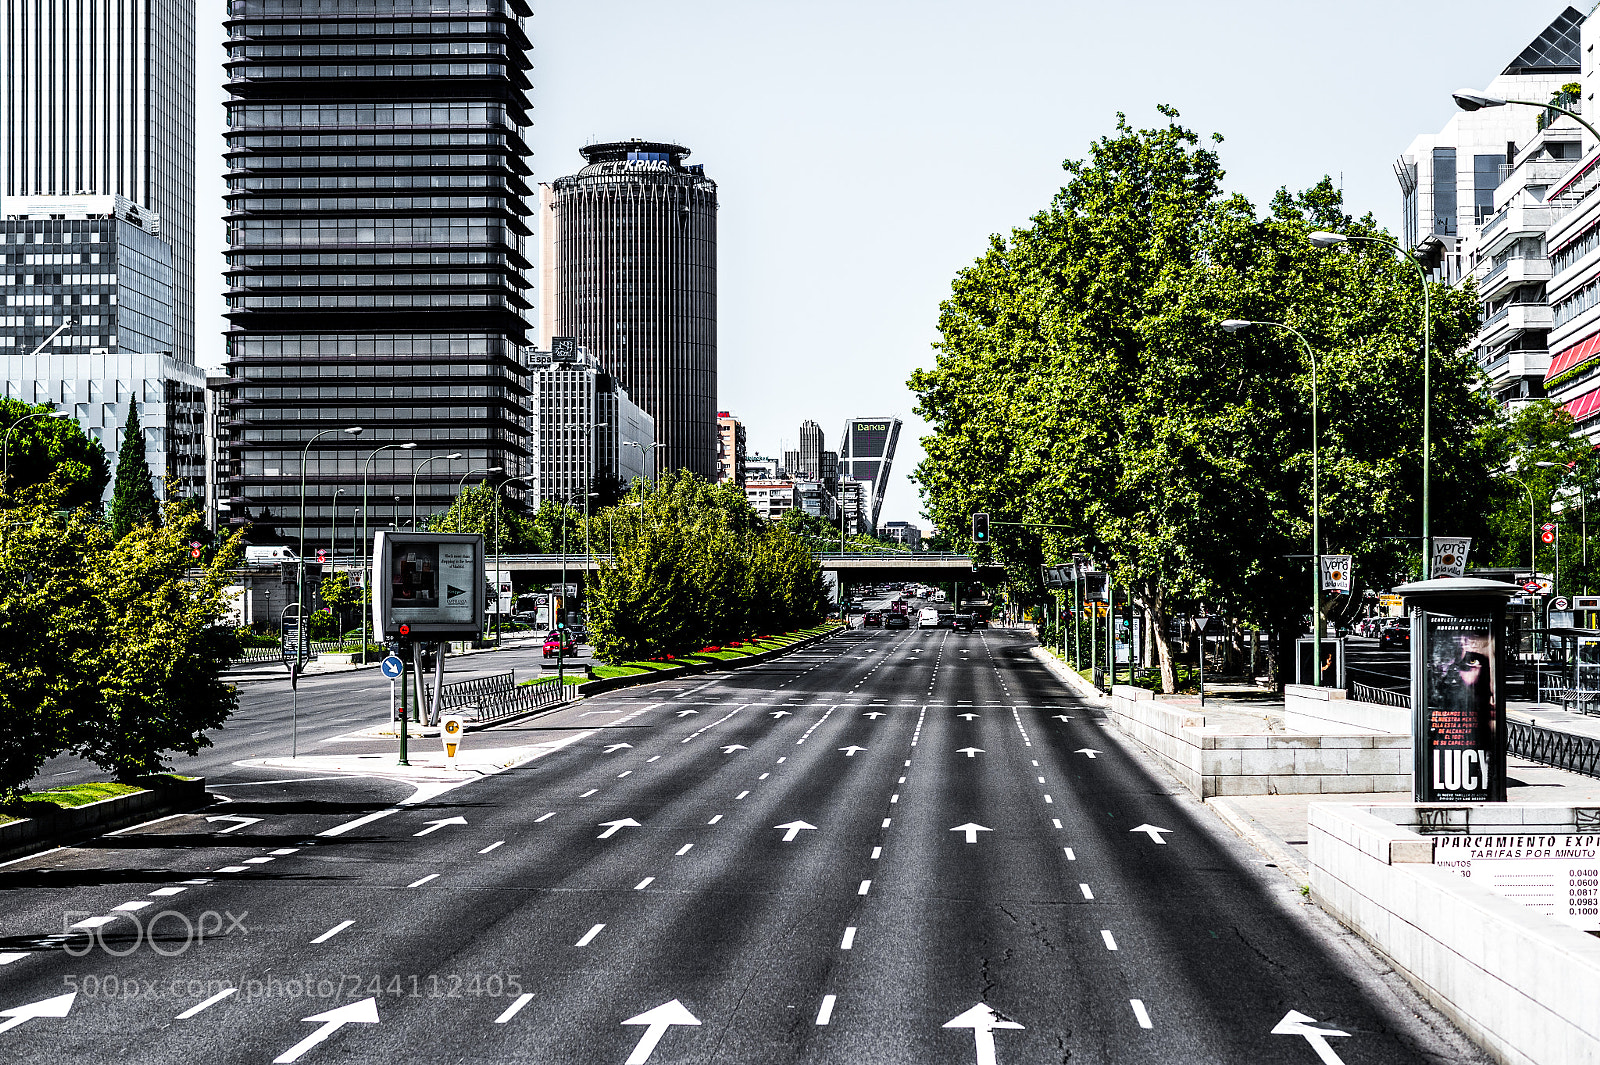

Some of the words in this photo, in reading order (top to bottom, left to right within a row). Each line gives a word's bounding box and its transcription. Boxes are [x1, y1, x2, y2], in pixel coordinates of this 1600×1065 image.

[624, 160, 667, 171] KPMG
[857, 423, 886, 431] Bankia
[1433, 749, 1490, 790] LUCY
[1432, 836, 1556, 848] APARCAMIENTO
[1470, 850, 1522, 858] TARIFAS
[1556, 850, 1596, 858] MINUTO
